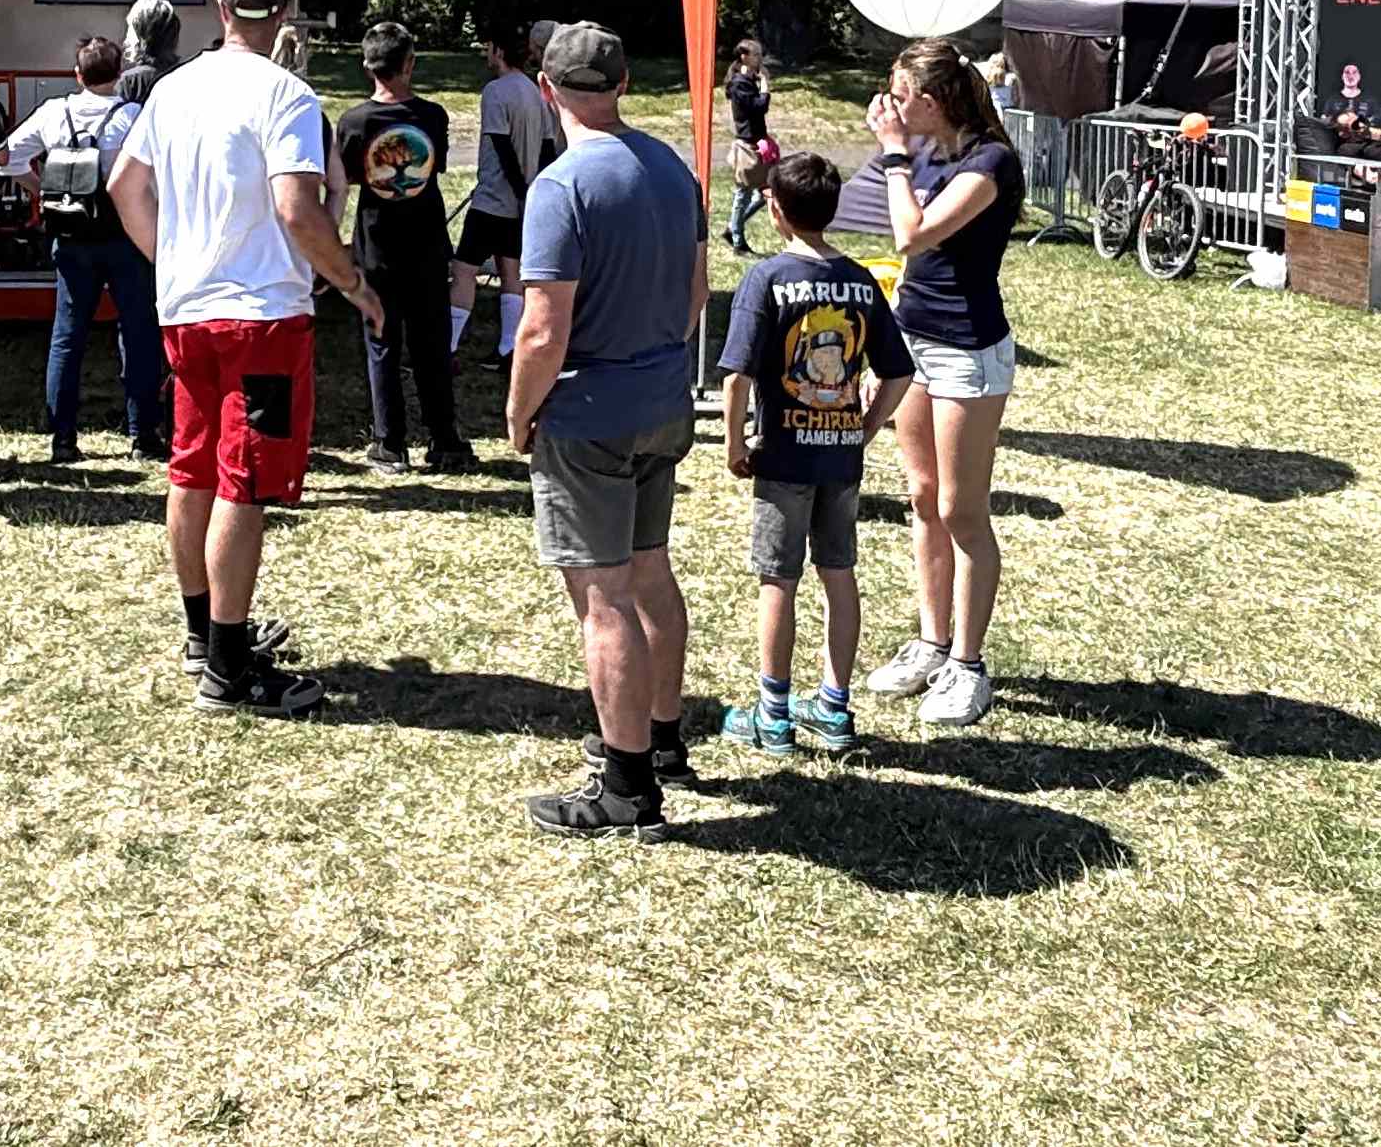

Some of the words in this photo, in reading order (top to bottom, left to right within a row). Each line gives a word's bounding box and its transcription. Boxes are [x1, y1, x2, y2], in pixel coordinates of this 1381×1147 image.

[771, 280, 874, 305] NARUTO
[782, 407, 863, 431] ICHIRAK
[796, 428, 839, 446] RAMEN
